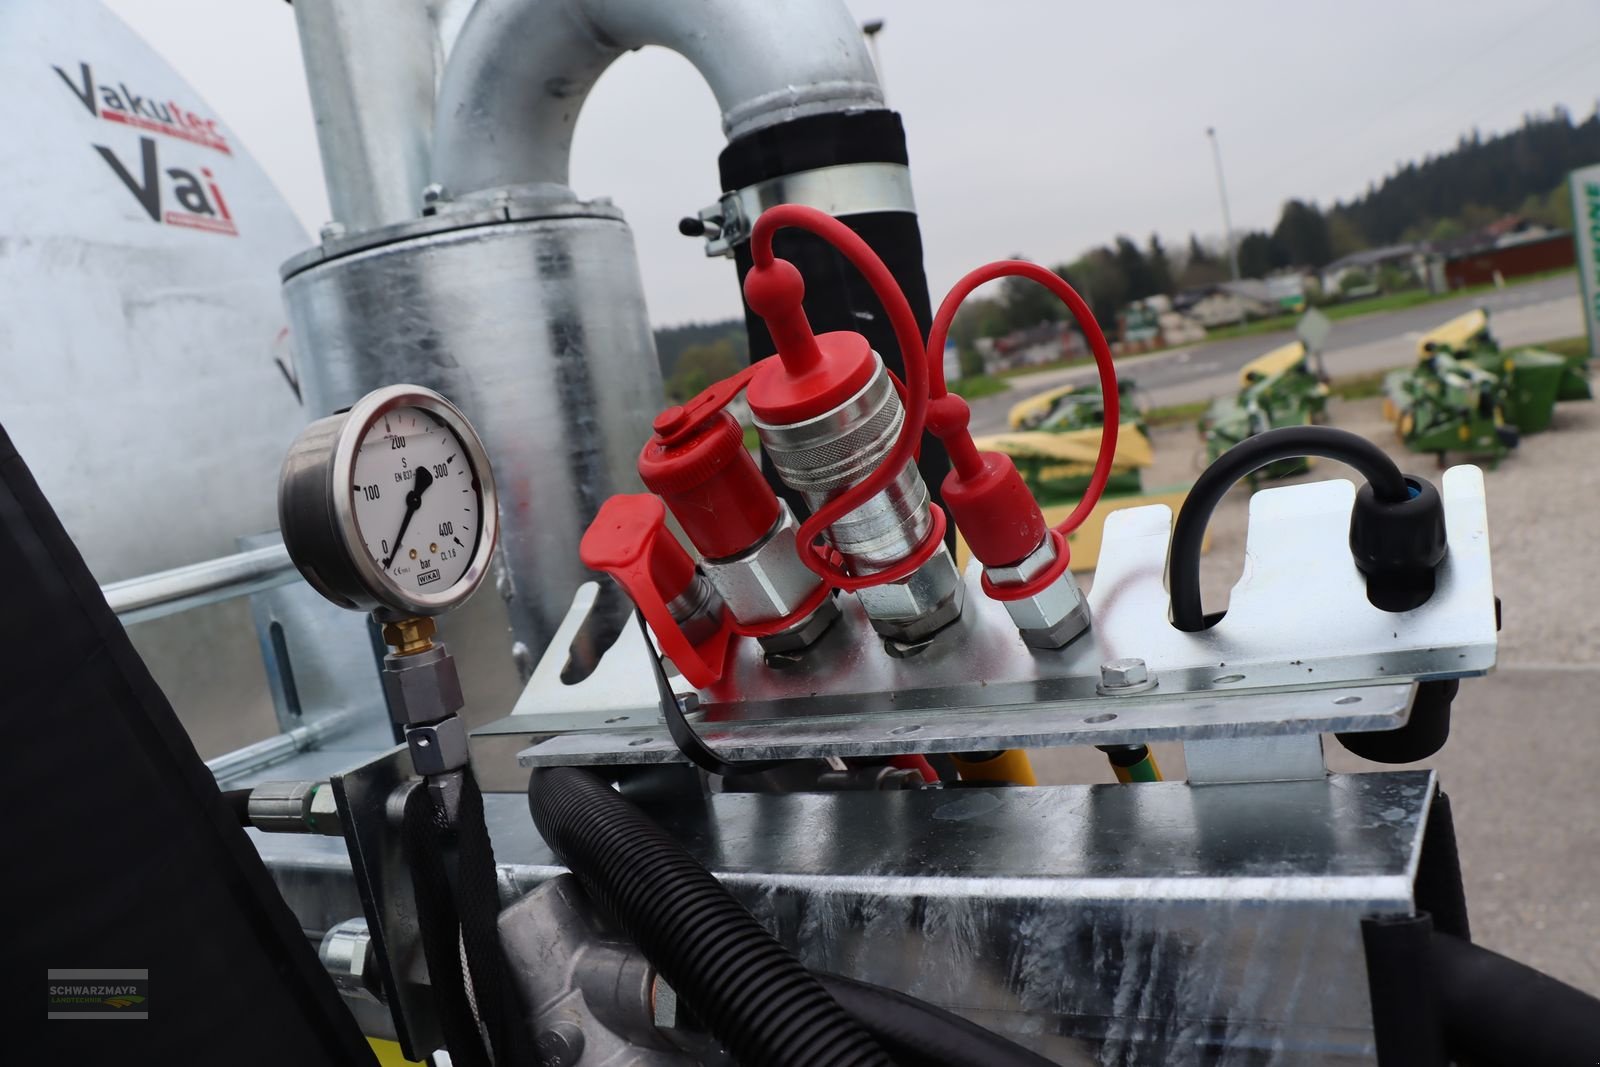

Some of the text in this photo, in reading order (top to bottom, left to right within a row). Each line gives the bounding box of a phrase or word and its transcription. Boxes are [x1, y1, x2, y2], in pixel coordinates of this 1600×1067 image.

[51, 61, 227, 141] Vakutec
[91, 136, 232, 223] Vai
[392, 436, 406, 450] 200
[401, 457, 407, 468] S
[394, 472, 402, 483] EN
[433, 462, 449, 479] 300
[364, 484, 380, 501] 100
[439, 521, 453, 536] 400
[382, 540, 388, 554] 0
[419, 559, 431, 570] bar
[418, 571, 438, 584] WIKA
